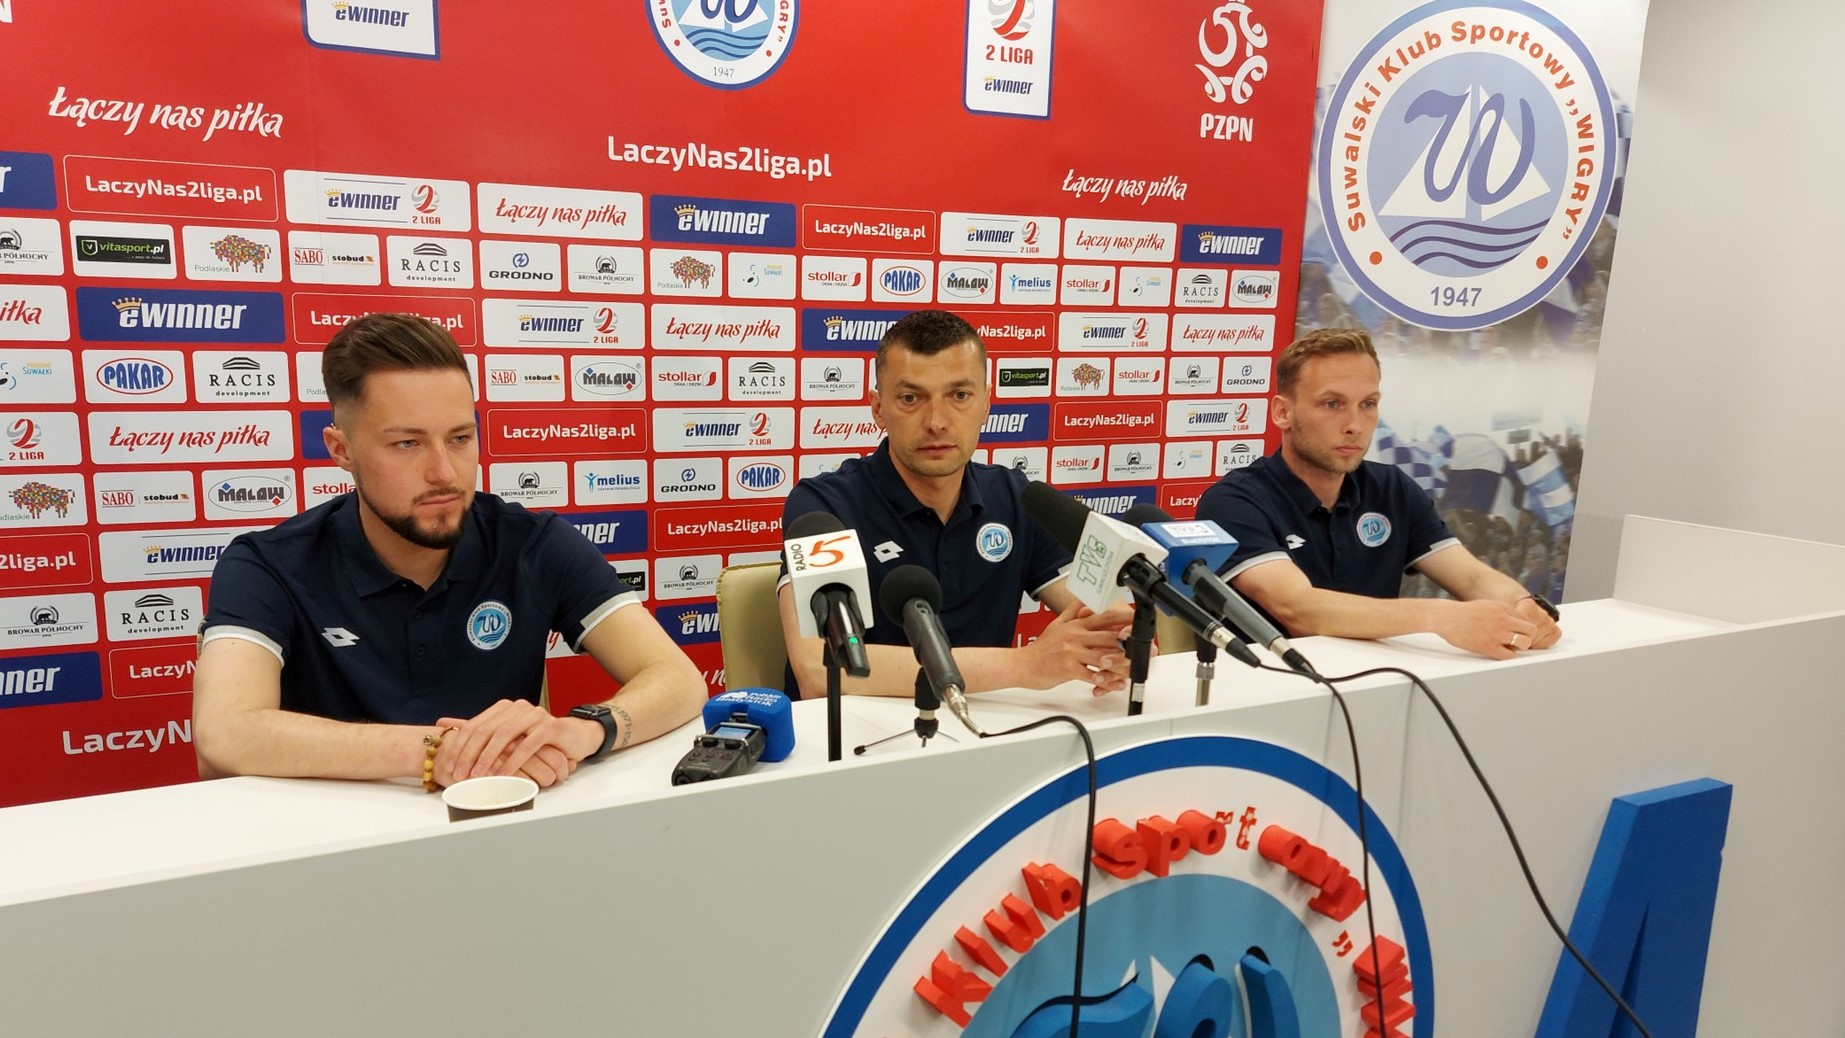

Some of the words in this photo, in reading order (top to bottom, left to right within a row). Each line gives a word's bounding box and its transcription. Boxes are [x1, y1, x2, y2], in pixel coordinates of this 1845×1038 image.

[985, 44, 995, 61] 2
[1000, 46, 1033, 65] LIGA
[712, 66, 735, 78] 1947
[48, 86, 144, 136] Łączy
[149, 104, 205, 131] nas
[202, 102, 284, 142] piłka
[1200, 113, 1254, 142] PZPN
[1343, 82, 1381, 232] Suwalski
[1377, 31, 1442, 82] Klub
[1451, 21, 1575, 90] Sportowy
[607, 136, 832, 181] LaczyNas2liga.pl
[85, 175, 263, 204] LaczyNas2liga.pl
[1062, 169, 1115, 203] Łączy
[1115, 178, 1145, 197] nas
[1141, 175, 1188, 205] piłka
[552, 207, 581, 223] nas
[581, 204, 627, 230] piłka
[815, 220, 926, 240] LaczyNas2liga.pl
[99, 242, 165, 254] vitasport.pl
[1112, 236, 1132, 249] nas
[294, 250, 323, 265] SABO
[401, 259, 461, 273] RACIS
[489, 270, 554, 281] GRODNO
[808, 272, 848, 282] stollar
[884, 270, 921, 292] PAKAR
[1018, 277, 1051, 288] melius
[1066, 278, 1099, 288] stollar
[1183, 287, 1219, 296] RACIS
[1430, 286, 1483, 308] 1947
[0, 300, 42, 325] iłka
[714, 325, 740, 338] nas
[740, 319, 780, 343] piłka
[977, 324, 1046, 340] Nas2liga.pl
[104, 362, 165, 390] PAKAR
[209, 374, 276, 387] RACIS
[491, 371, 517, 385] SABO
[658, 371, 702, 382] stollar
[739, 376, 786, 387] RACIS
[1119, 370, 1150, 379] stollar
[1227, 378, 1266, 386] GRODNO
[306, 387, 328, 396] Podlas
[1064, 413, 1155, 428] LaczyNas2liga.pl
[109, 426, 174, 455] Łączy
[178, 432, 215, 447] nas
[214, 424, 271, 454] piłka
[503, 424, 636, 441] LaczyNas2liga.pl
[9, 451, 16, 460] 2
[20, 451, 45, 460] LIGA
[1056, 458, 1089, 468] stollar
[597, 474, 640, 486] melius
[741, 466, 780, 488] PAKAR
[661, 484, 716, 493] GRODNO
[102, 491, 134, 506] SABO
[791, 543, 806, 572] RADIO
[809, 535, 851, 567] 5
[121, 609, 190, 625] RACIS
[7, 627, 39, 636] BROWAR
[128, 624, 184, 634] development
